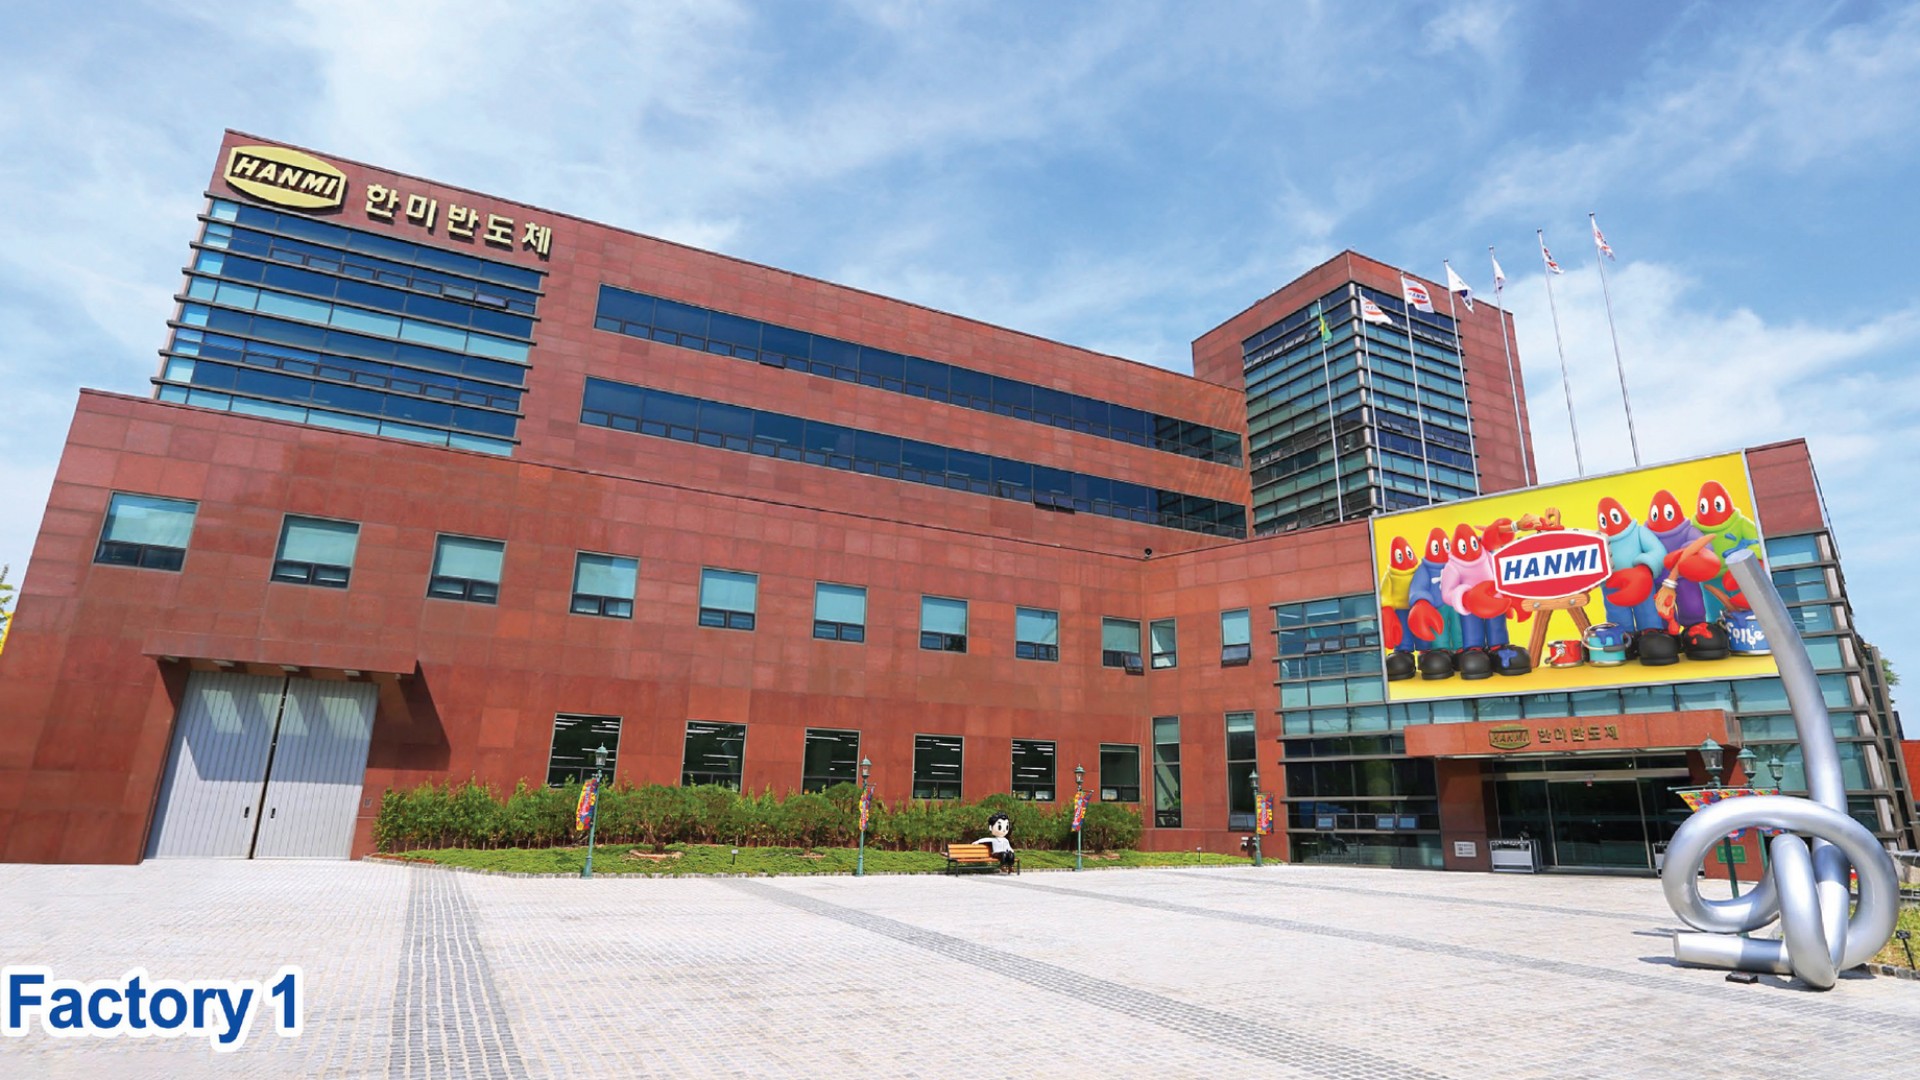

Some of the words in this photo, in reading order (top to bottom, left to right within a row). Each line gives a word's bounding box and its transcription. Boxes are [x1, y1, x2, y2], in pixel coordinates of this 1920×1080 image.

[233, 157, 339, 195] HANMI
[366, 184, 552, 255] 한미반도체
[1504, 548, 1598, 581] HANMI
